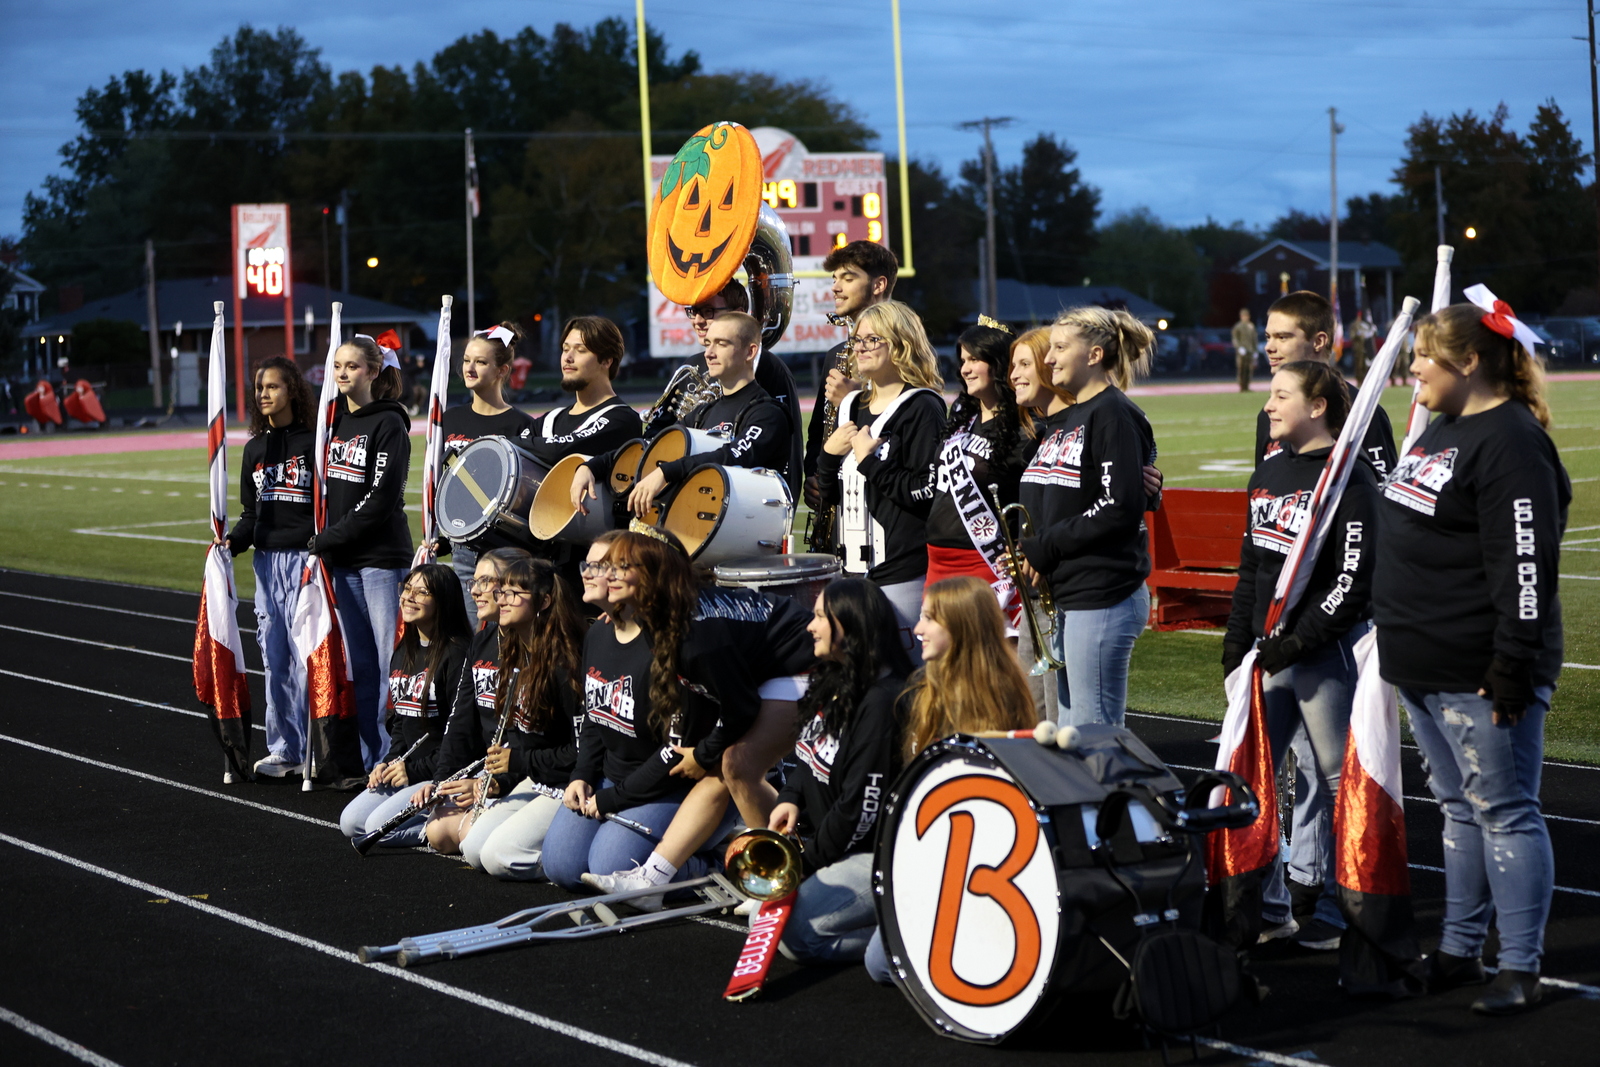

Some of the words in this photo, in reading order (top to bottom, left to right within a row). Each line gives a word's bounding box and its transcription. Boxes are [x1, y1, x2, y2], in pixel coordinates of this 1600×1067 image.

[803, 159, 882, 175] REDMEN
[863, 192, 881, 219] 0
[247, 263, 283, 295] 40
[1343, 521, 1363, 572] COLOR
[1513, 498, 1536, 556] COLOR
[1320, 572, 1354, 616] GUARD
[1517, 562, 1539, 620] GUARD
[915, 773, 1042, 1007] B
[733, 907, 783, 977] BELLEVUE
